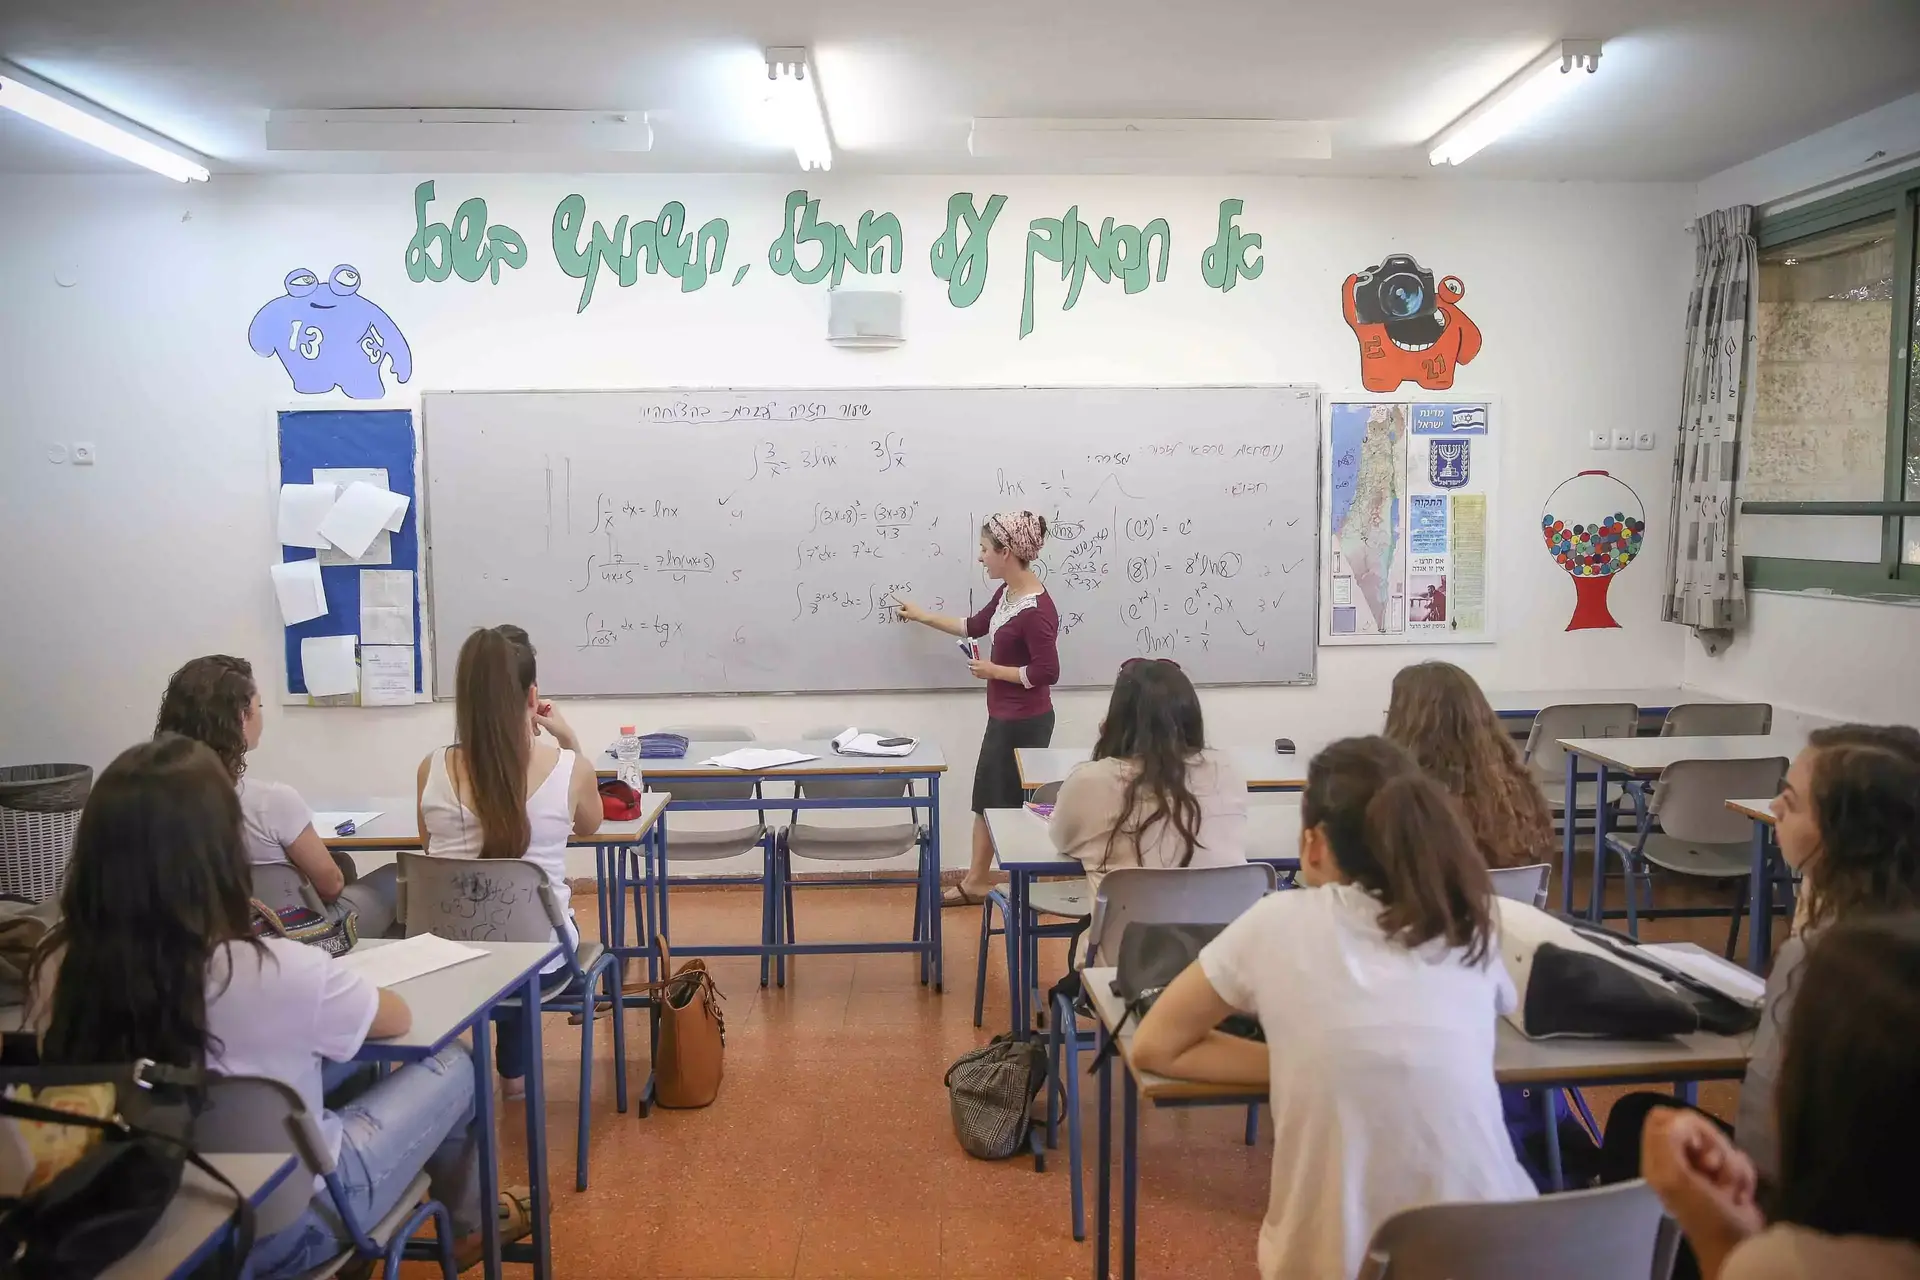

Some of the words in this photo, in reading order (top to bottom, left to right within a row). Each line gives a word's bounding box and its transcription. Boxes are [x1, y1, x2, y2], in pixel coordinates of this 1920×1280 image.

[405, 180, 528, 285] בשכל
[552, 194, 730, 314] תשתמש
[930, 192, 1008, 309] על
[1020, 205, 1171, 340] תסמוך
[1201, 198, 1264, 293] אל
[288, 319, 325, 361] 13
[1421, 353, 1447, 380] 21
[1417, 420, 1444, 429] ישראל
[1419, 409, 1445, 418] מדינת
